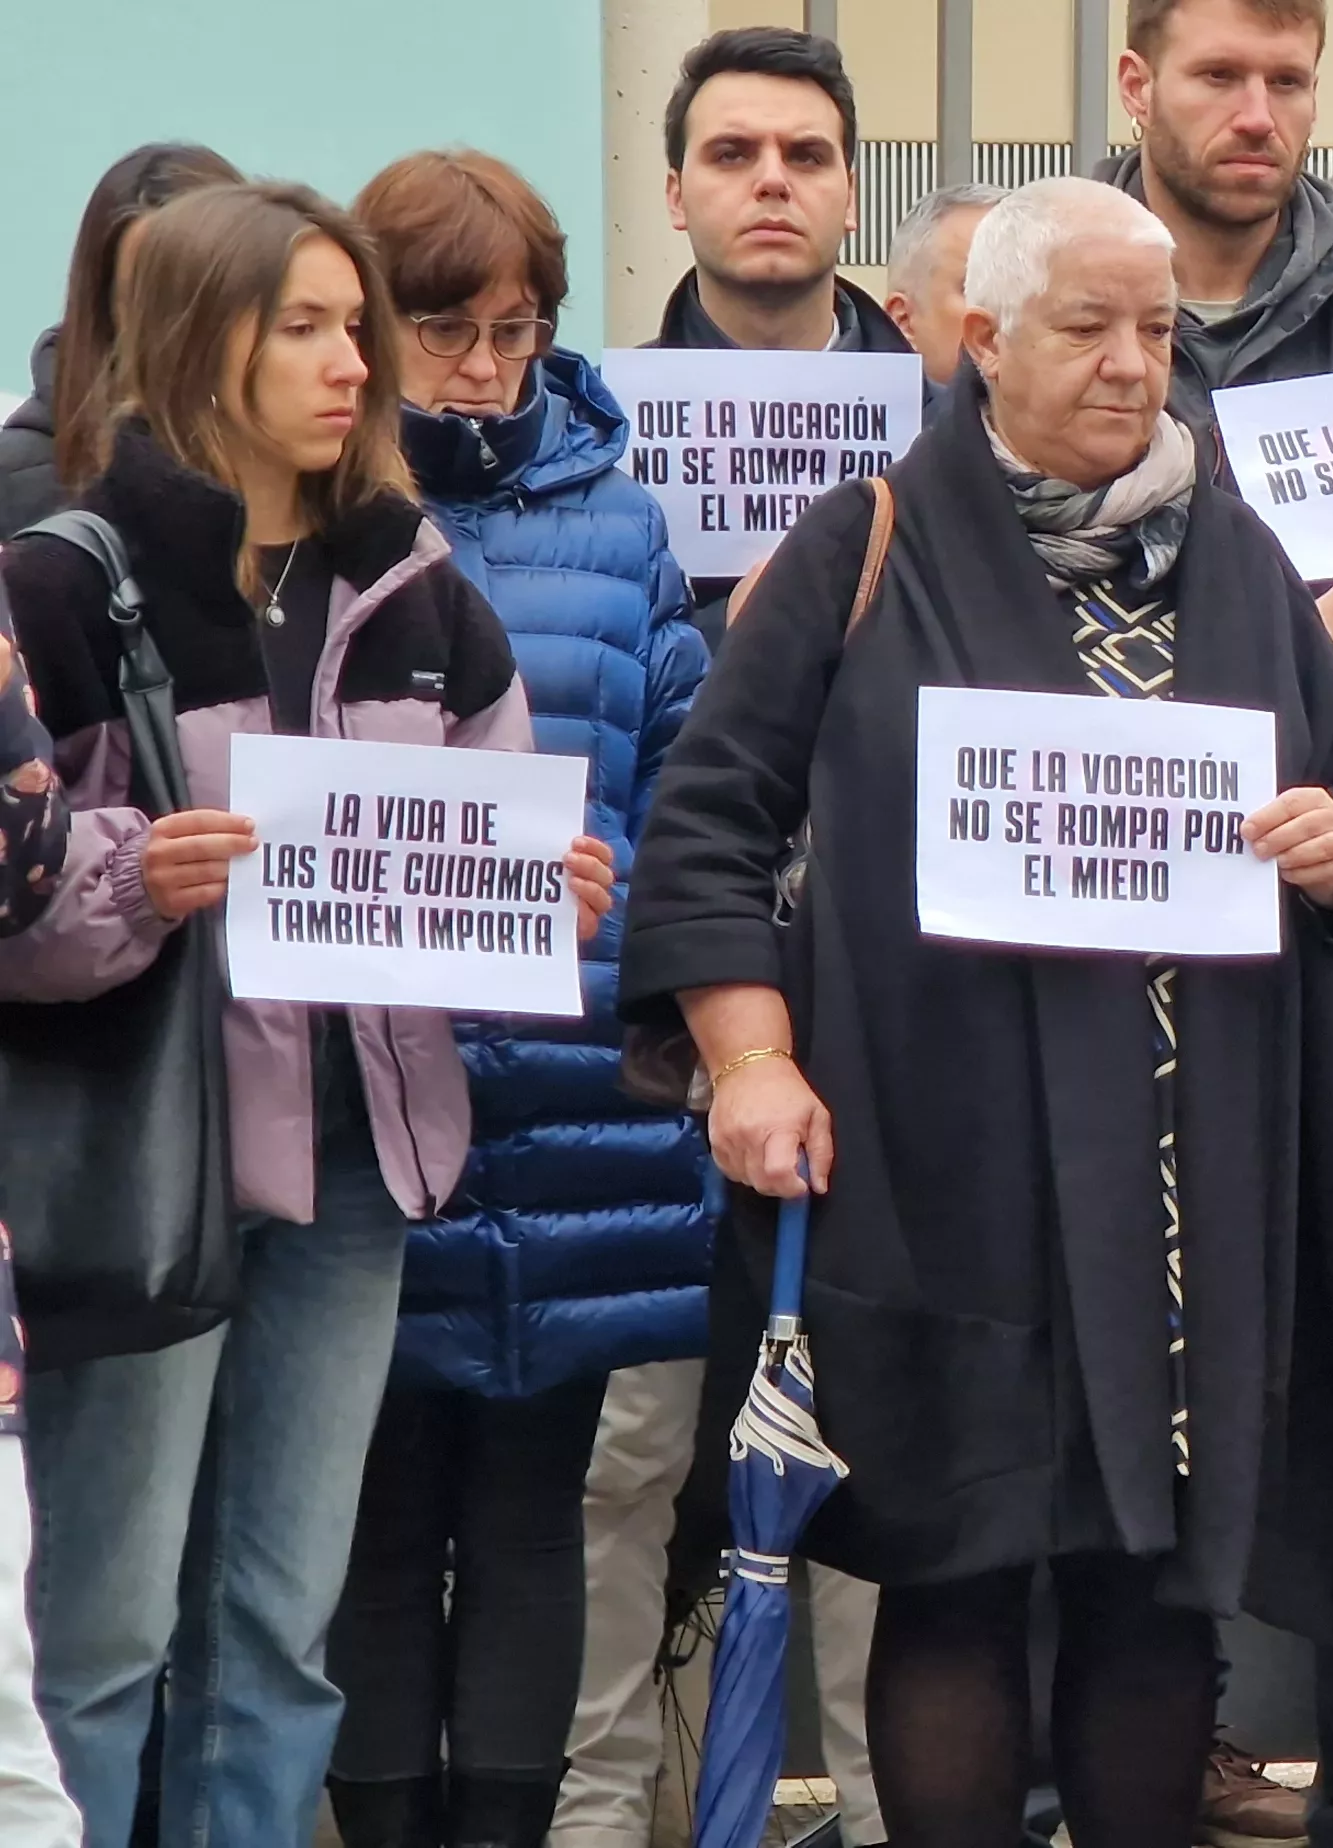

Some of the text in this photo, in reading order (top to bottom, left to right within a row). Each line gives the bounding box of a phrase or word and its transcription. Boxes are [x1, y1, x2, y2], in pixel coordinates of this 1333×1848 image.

[637, 396, 887, 441] QUE LA VOCACIÓN
[632, 447, 668, 485] NO
[682, 447, 716, 485] SE
[729, 447, 826, 486] ROMPA
[1258, 428, 1318, 466] QUE
[1265, 467, 1308, 505] NO
[700, 494, 820, 532] EL MIE
[957, 746, 1238, 801] QUE LA VOCACIÓN
[325, 792, 498, 846] LA VIDA DE
[950, 798, 1245, 855] NO SE ROMPA POR
[262, 843, 564, 904] LAS QUE CUIDAMOS
[1024, 854, 1170, 902] EL MIEDO
[267, 896, 552, 956] TAMBIÉN IMPORTA
